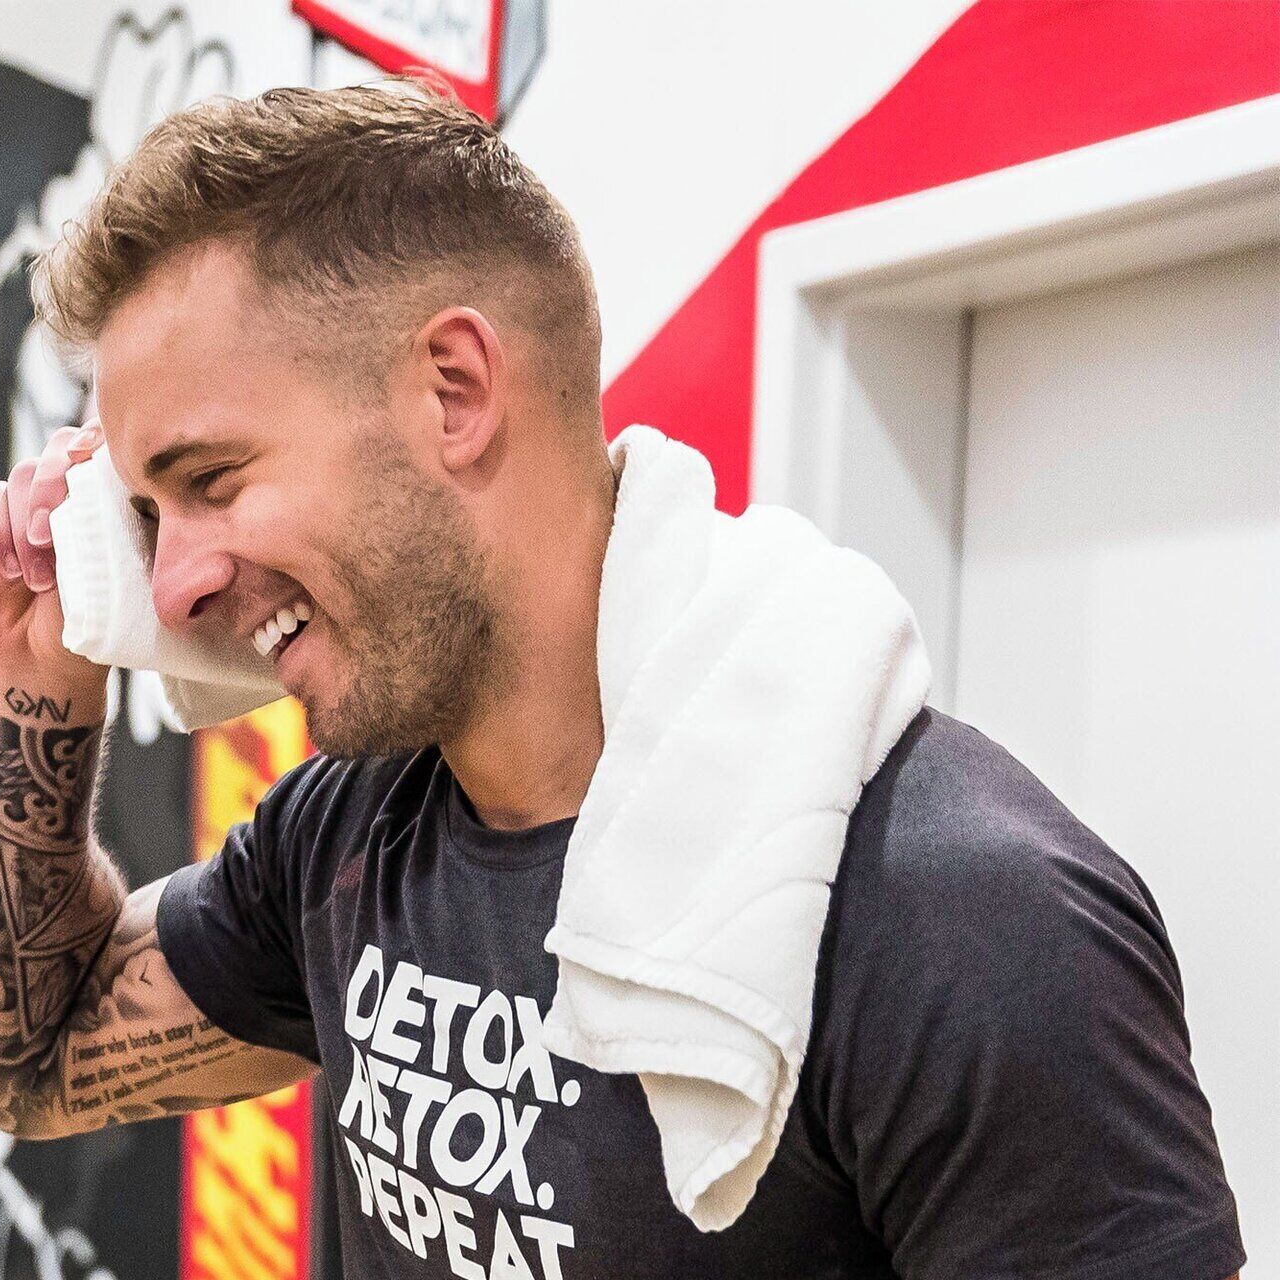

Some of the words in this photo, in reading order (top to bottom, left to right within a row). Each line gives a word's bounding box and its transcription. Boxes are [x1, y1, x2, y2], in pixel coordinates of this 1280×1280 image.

[127, 1029, 164, 1049] birds
[345, 943, 582, 1107] DETOX.
[338, 1043, 556, 1211] RETOX.
